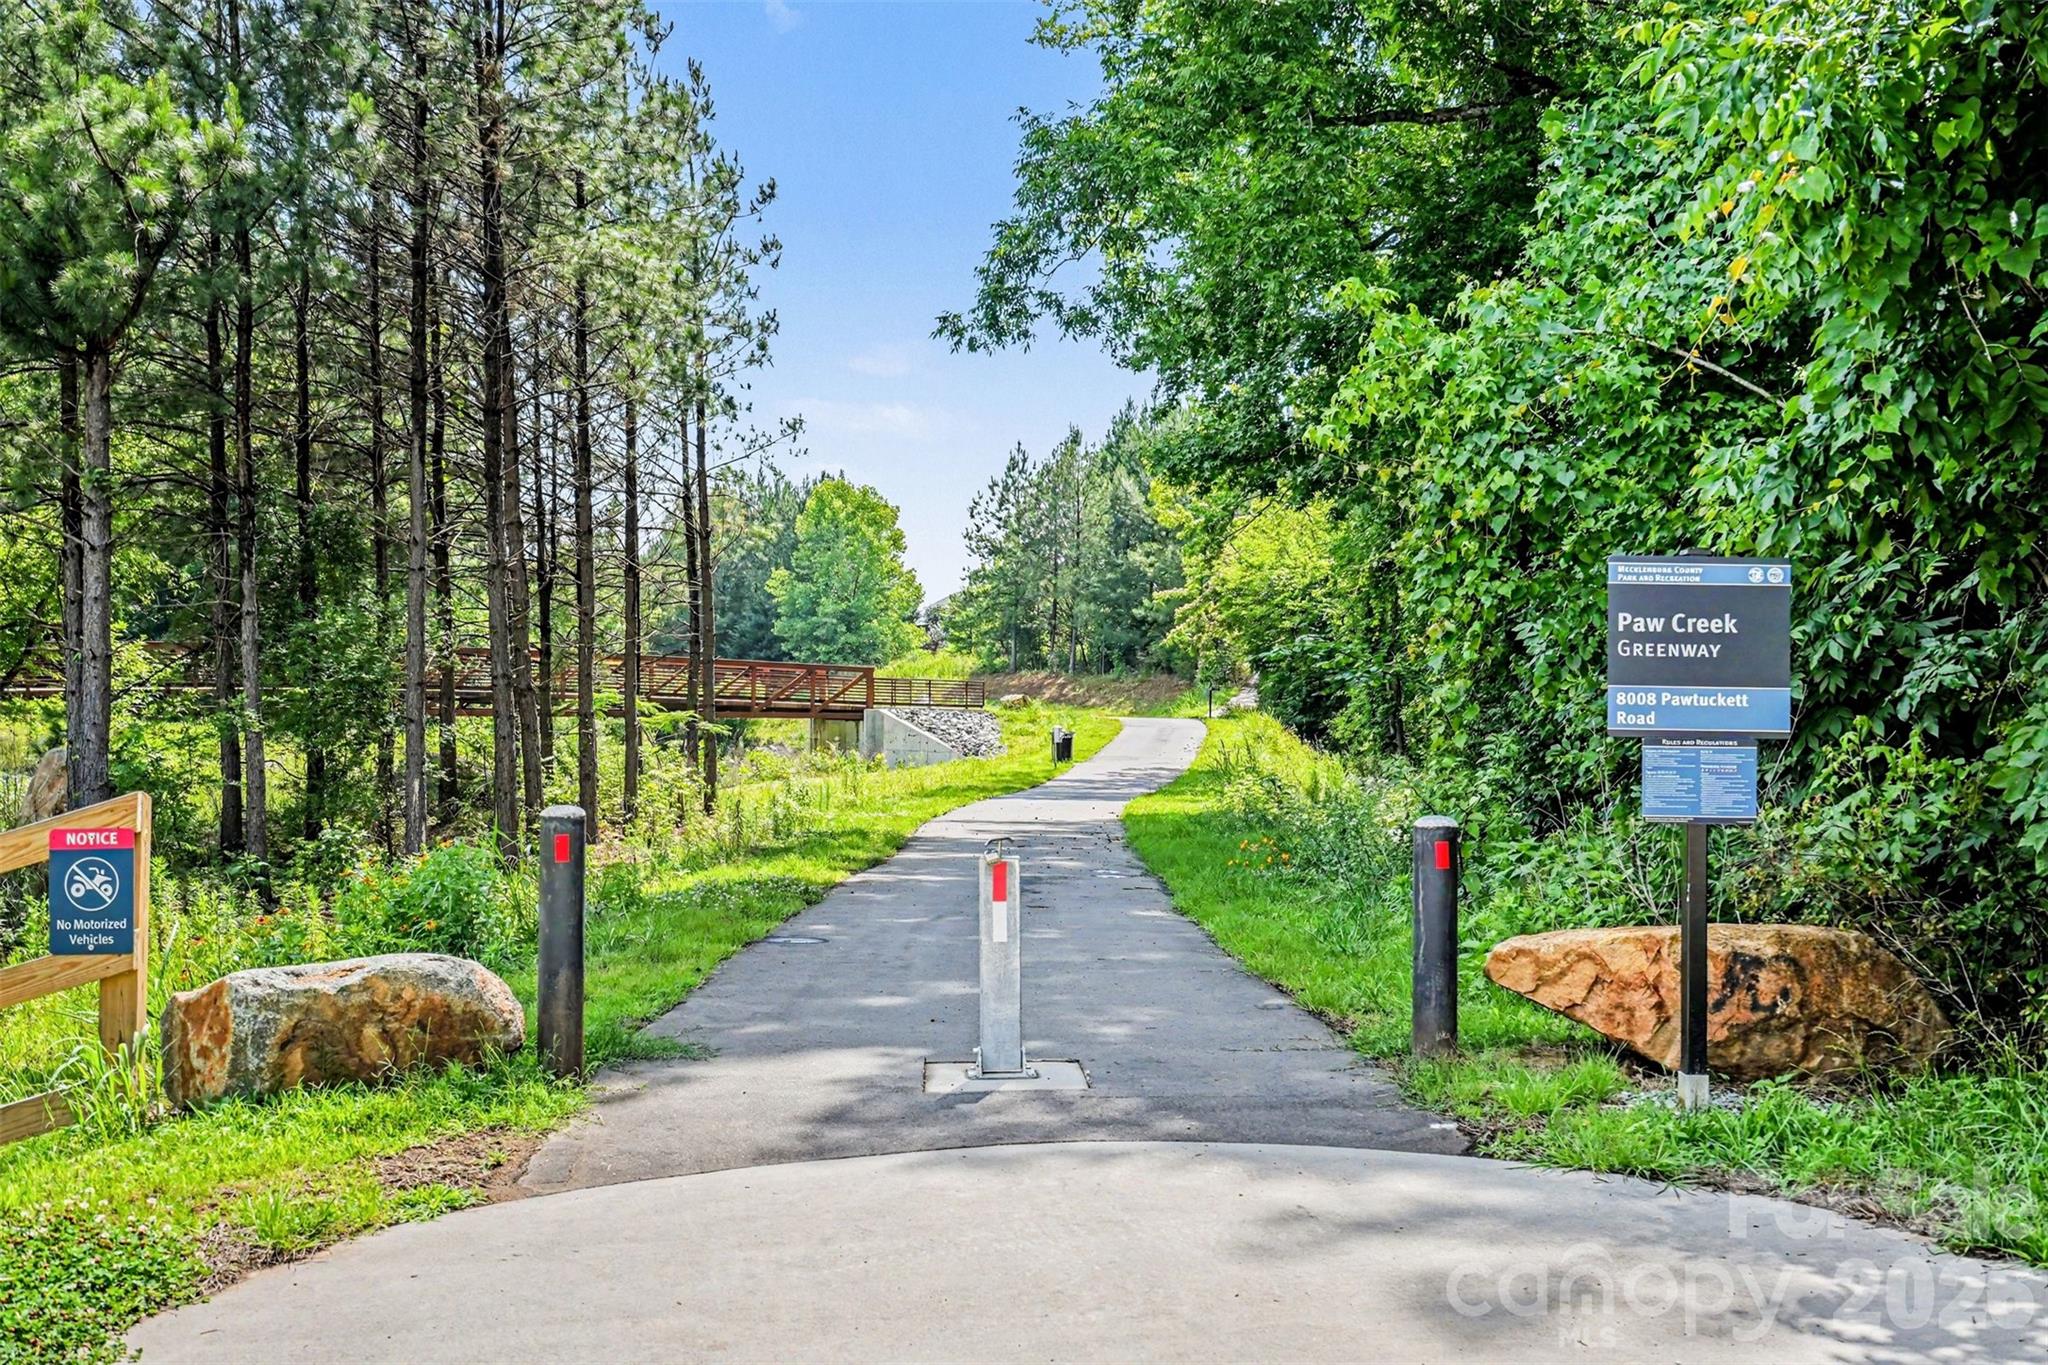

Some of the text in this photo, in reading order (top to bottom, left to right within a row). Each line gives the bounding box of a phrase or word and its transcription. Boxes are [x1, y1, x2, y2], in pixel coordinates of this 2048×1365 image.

[1617, 573, 1638, 581] PARK
[1617, 612, 1738, 634] Paw Creek
[1617, 640, 1721, 658] GREENWAY
[1616, 692, 1749, 708] 8008 Pawtuckett
[1616, 711, 1655, 725] Road
[66, 832, 118, 846] NOTICE
[56, 918, 127, 930] No Motorized
[69, 934, 114, 945] Vehicles
